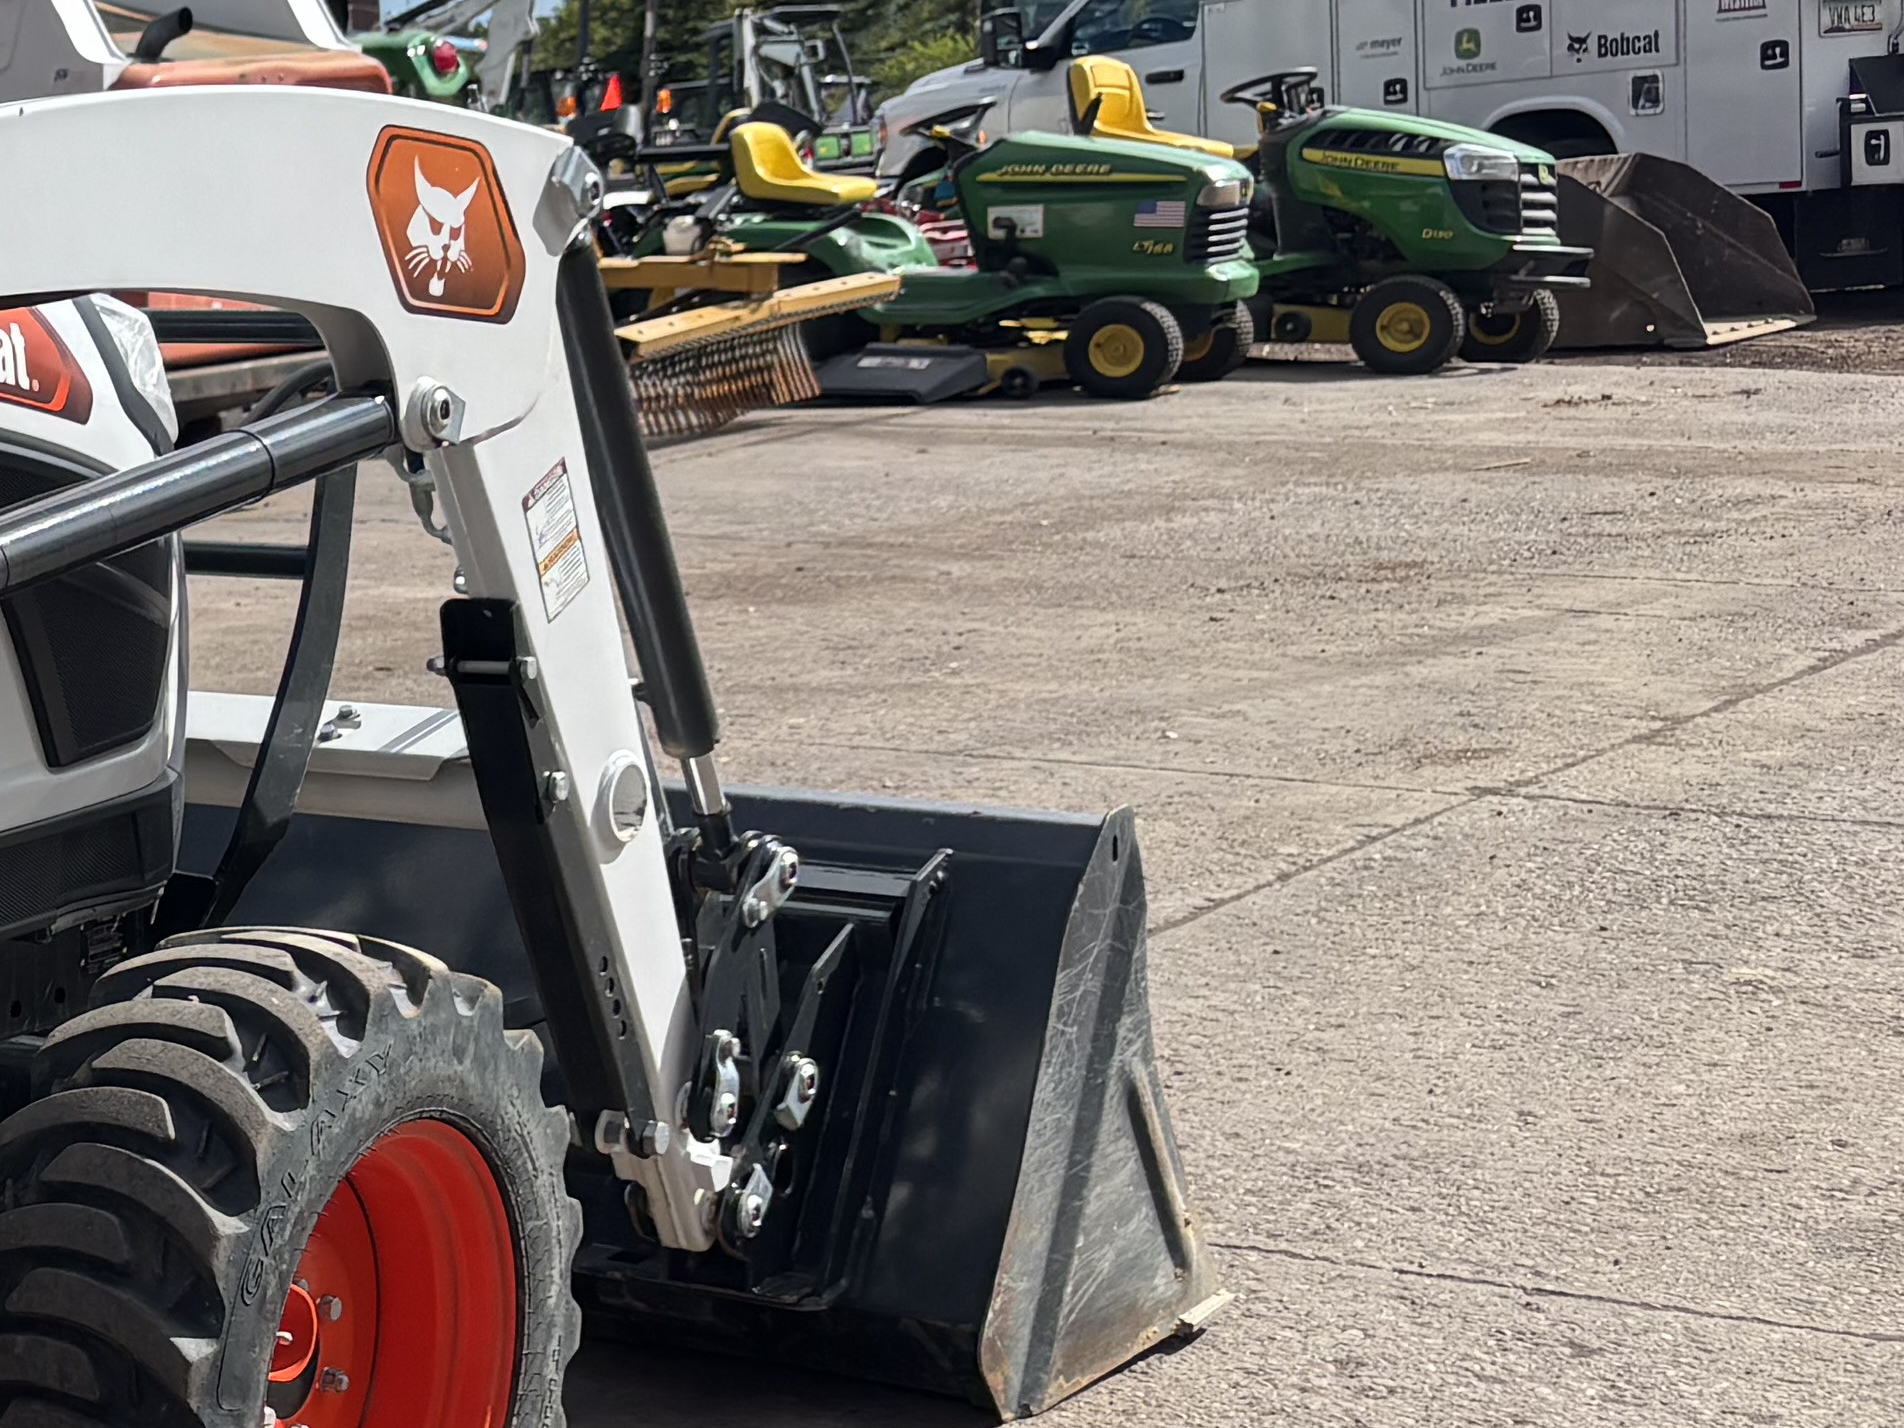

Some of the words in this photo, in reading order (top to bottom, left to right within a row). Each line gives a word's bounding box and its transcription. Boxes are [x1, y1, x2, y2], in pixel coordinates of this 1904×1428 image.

[1597, 29, 1660, 59] Bobcat
[1441, 65, 1465, 77] JOHN
[1465, 62, 1497, 73] DEERE
[998, 164, 1046, 176] JOHN
[1050, 163, 1113, 176] DEERE
[1322, 151, 1352, 167] JOHN
[1354, 155, 1400, 172] DEERE
